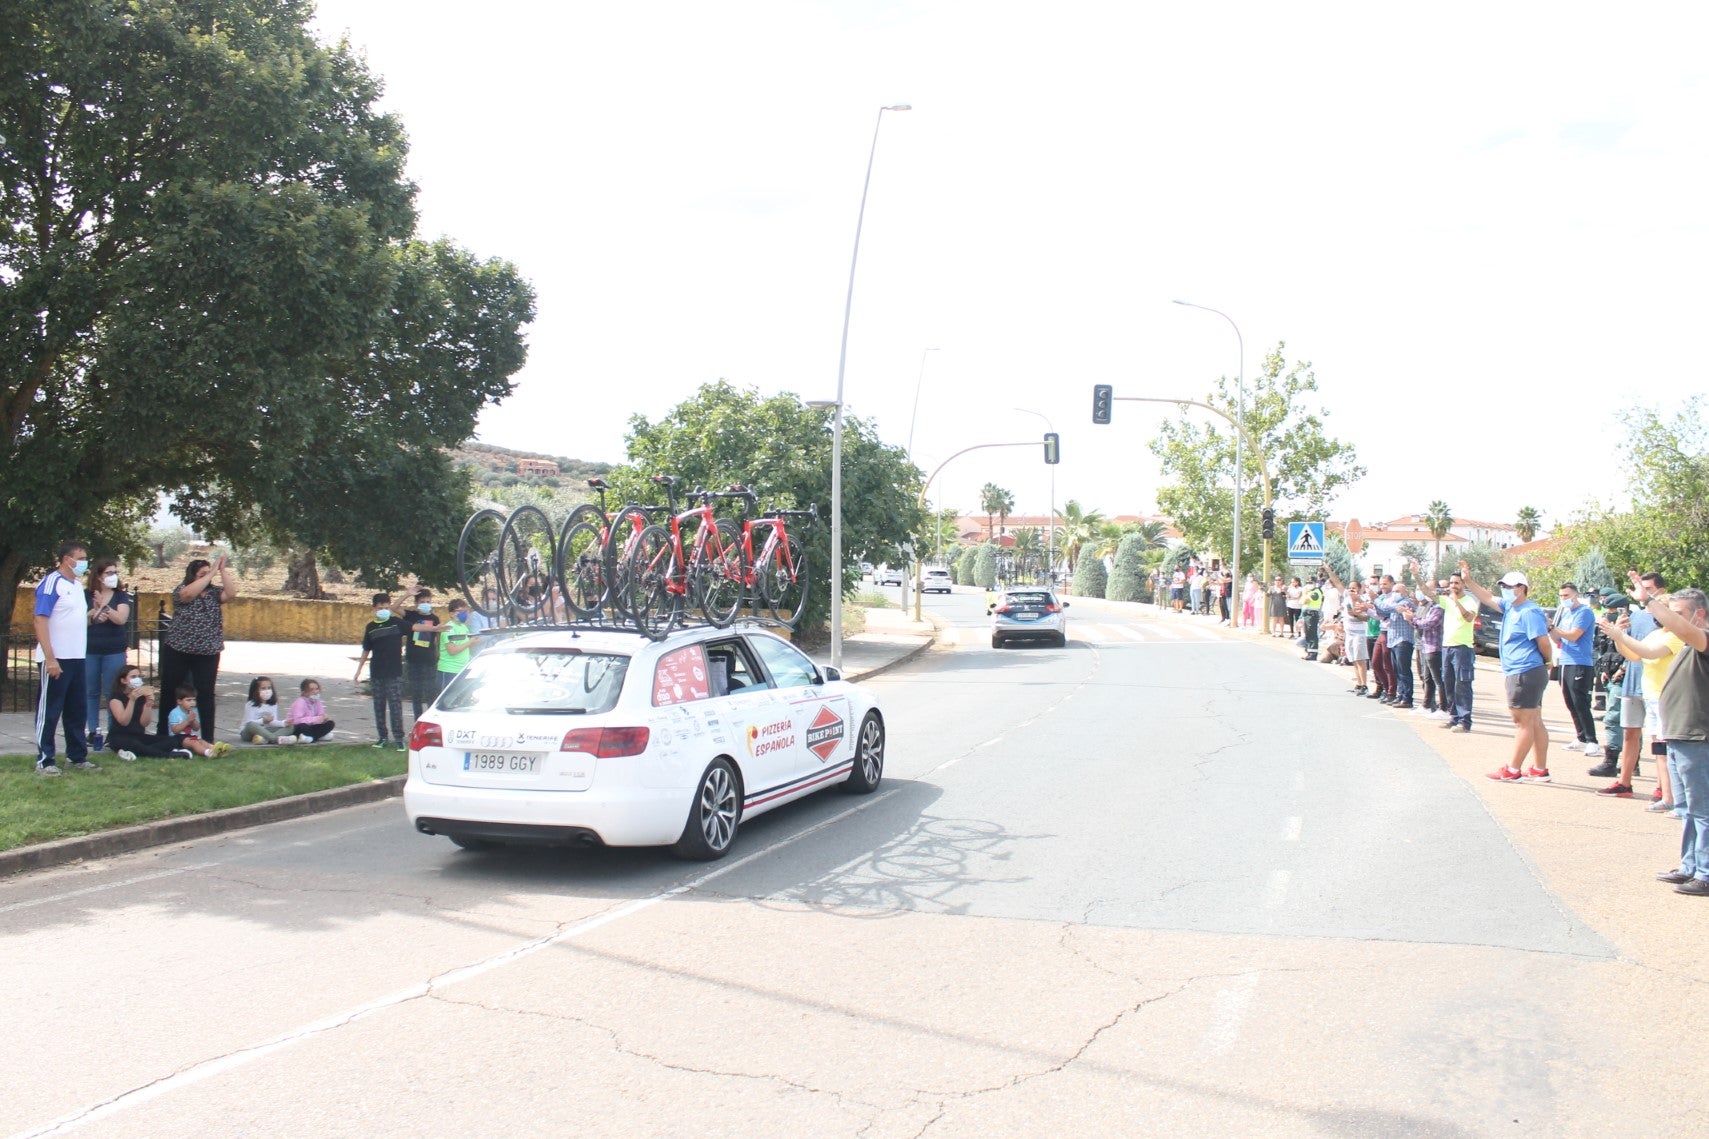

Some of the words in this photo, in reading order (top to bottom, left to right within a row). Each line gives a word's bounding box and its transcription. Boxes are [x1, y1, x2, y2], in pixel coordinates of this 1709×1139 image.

[456, 730, 477, 739] DXT
[755, 735, 795, 757] ESPAÑOLA
[474, 754, 505, 771] 1989
[509, 756, 537, 771] GGY
